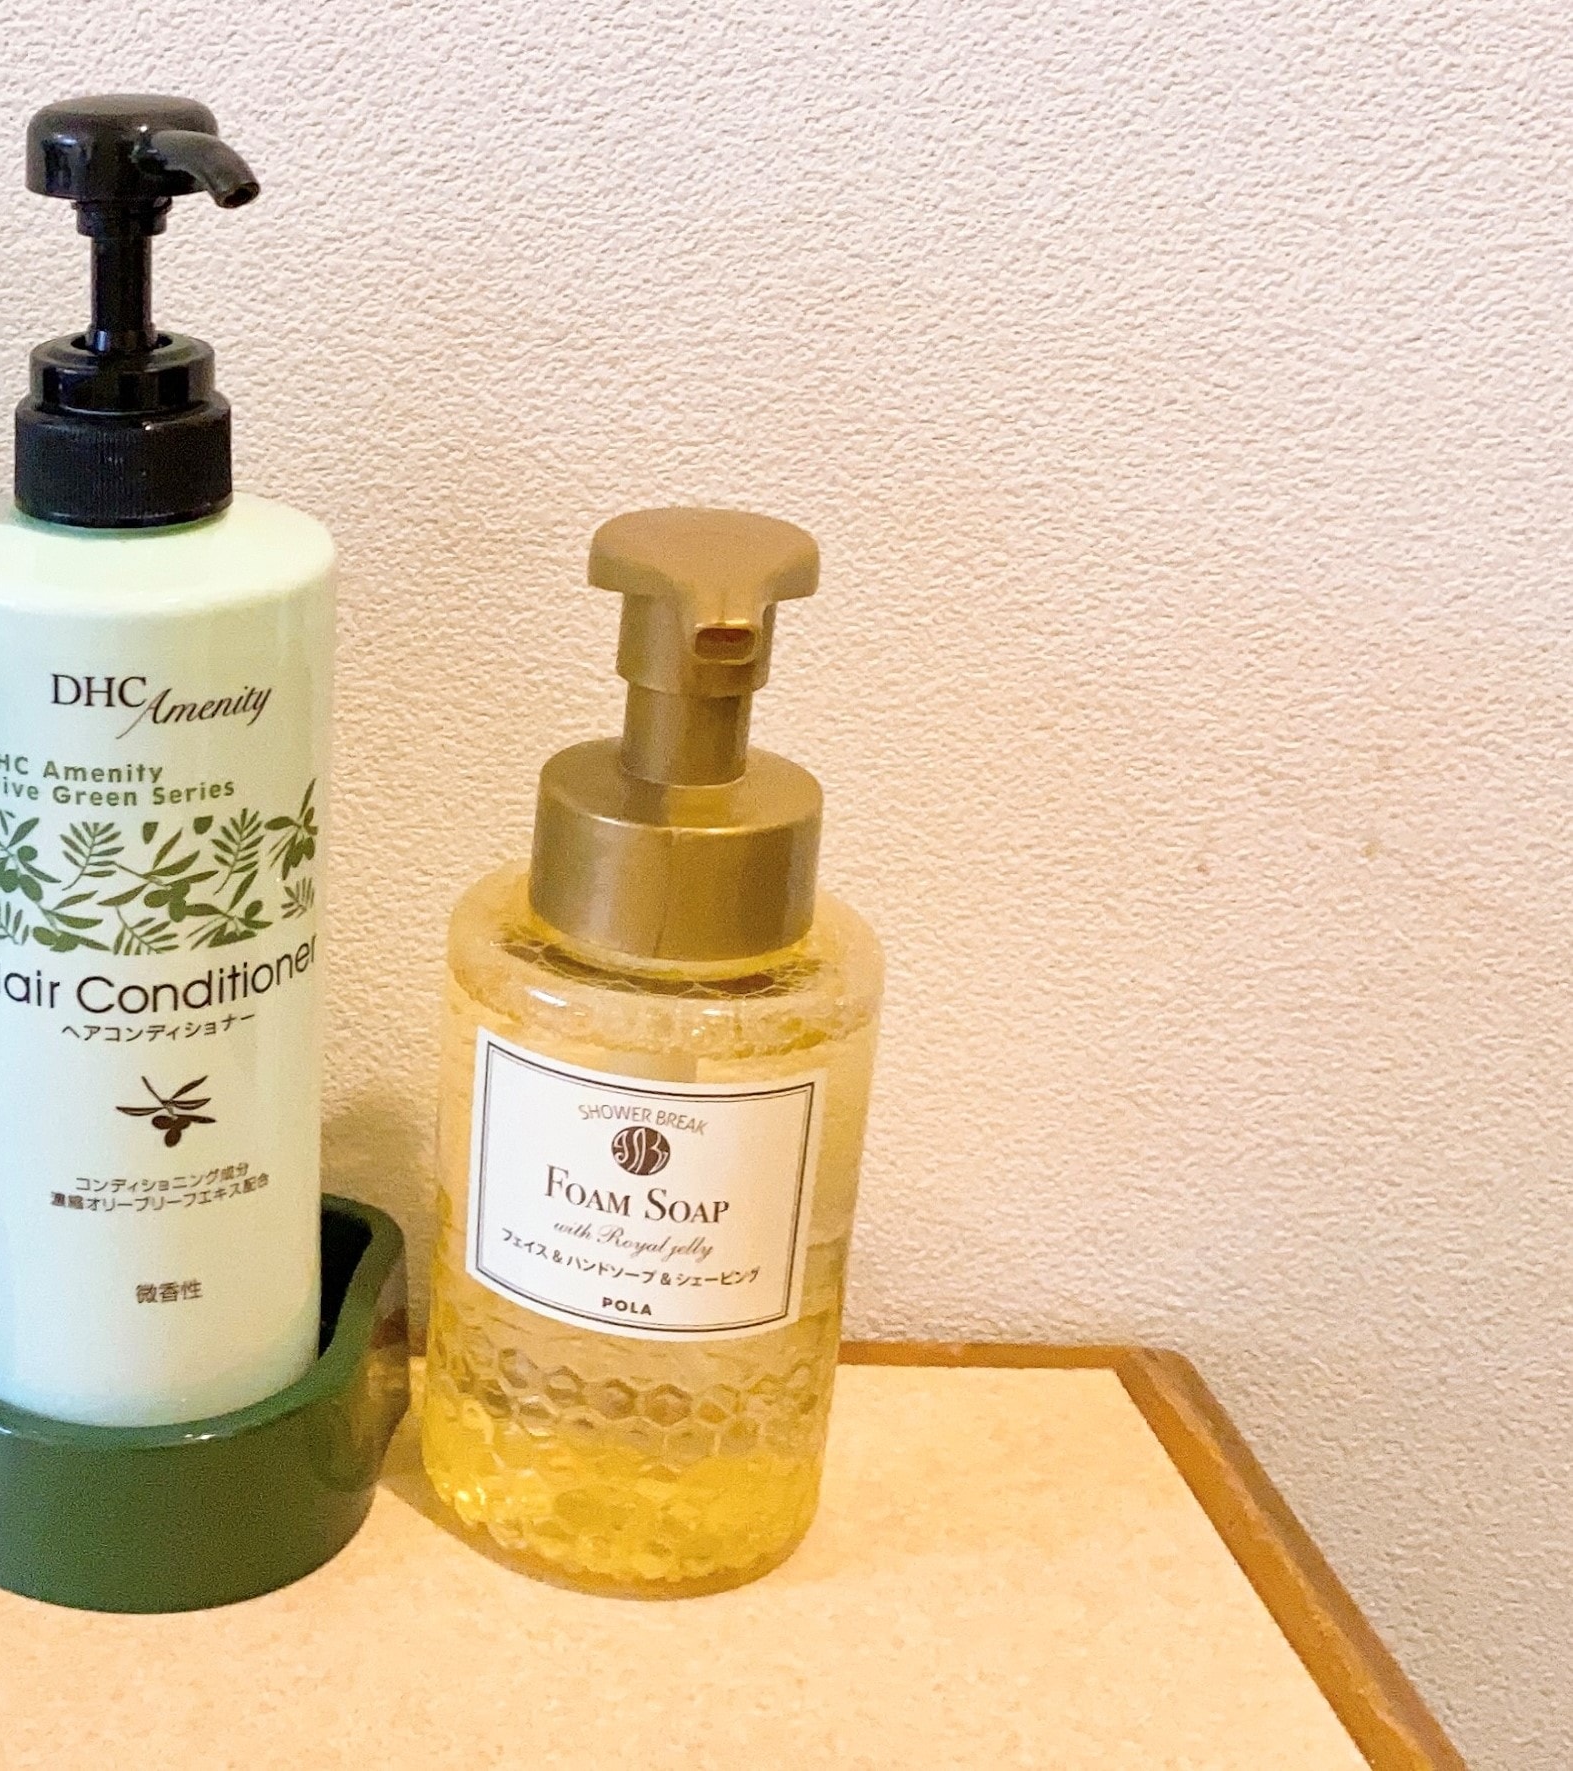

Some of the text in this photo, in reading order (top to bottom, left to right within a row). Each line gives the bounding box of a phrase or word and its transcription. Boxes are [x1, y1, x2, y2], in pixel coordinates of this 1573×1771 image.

[51, 674, 272, 739] DHC Amenity
[43, 760, 164, 784] Amenity
[53, 785, 137, 806] Green
[152, 780, 235, 805] Series
[76, 934, 316, 1014] Conditioner
[62, 1013, 255, 1043] ヘアコンディショナー
[578, 1104, 709, 1135] SHOWER BREAK
[76, 1162, 249, 1193] コンディショニング成分
[553, 1220, 714, 1264] with Royal jelly
[601, 1296, 653, 1317] POLA
